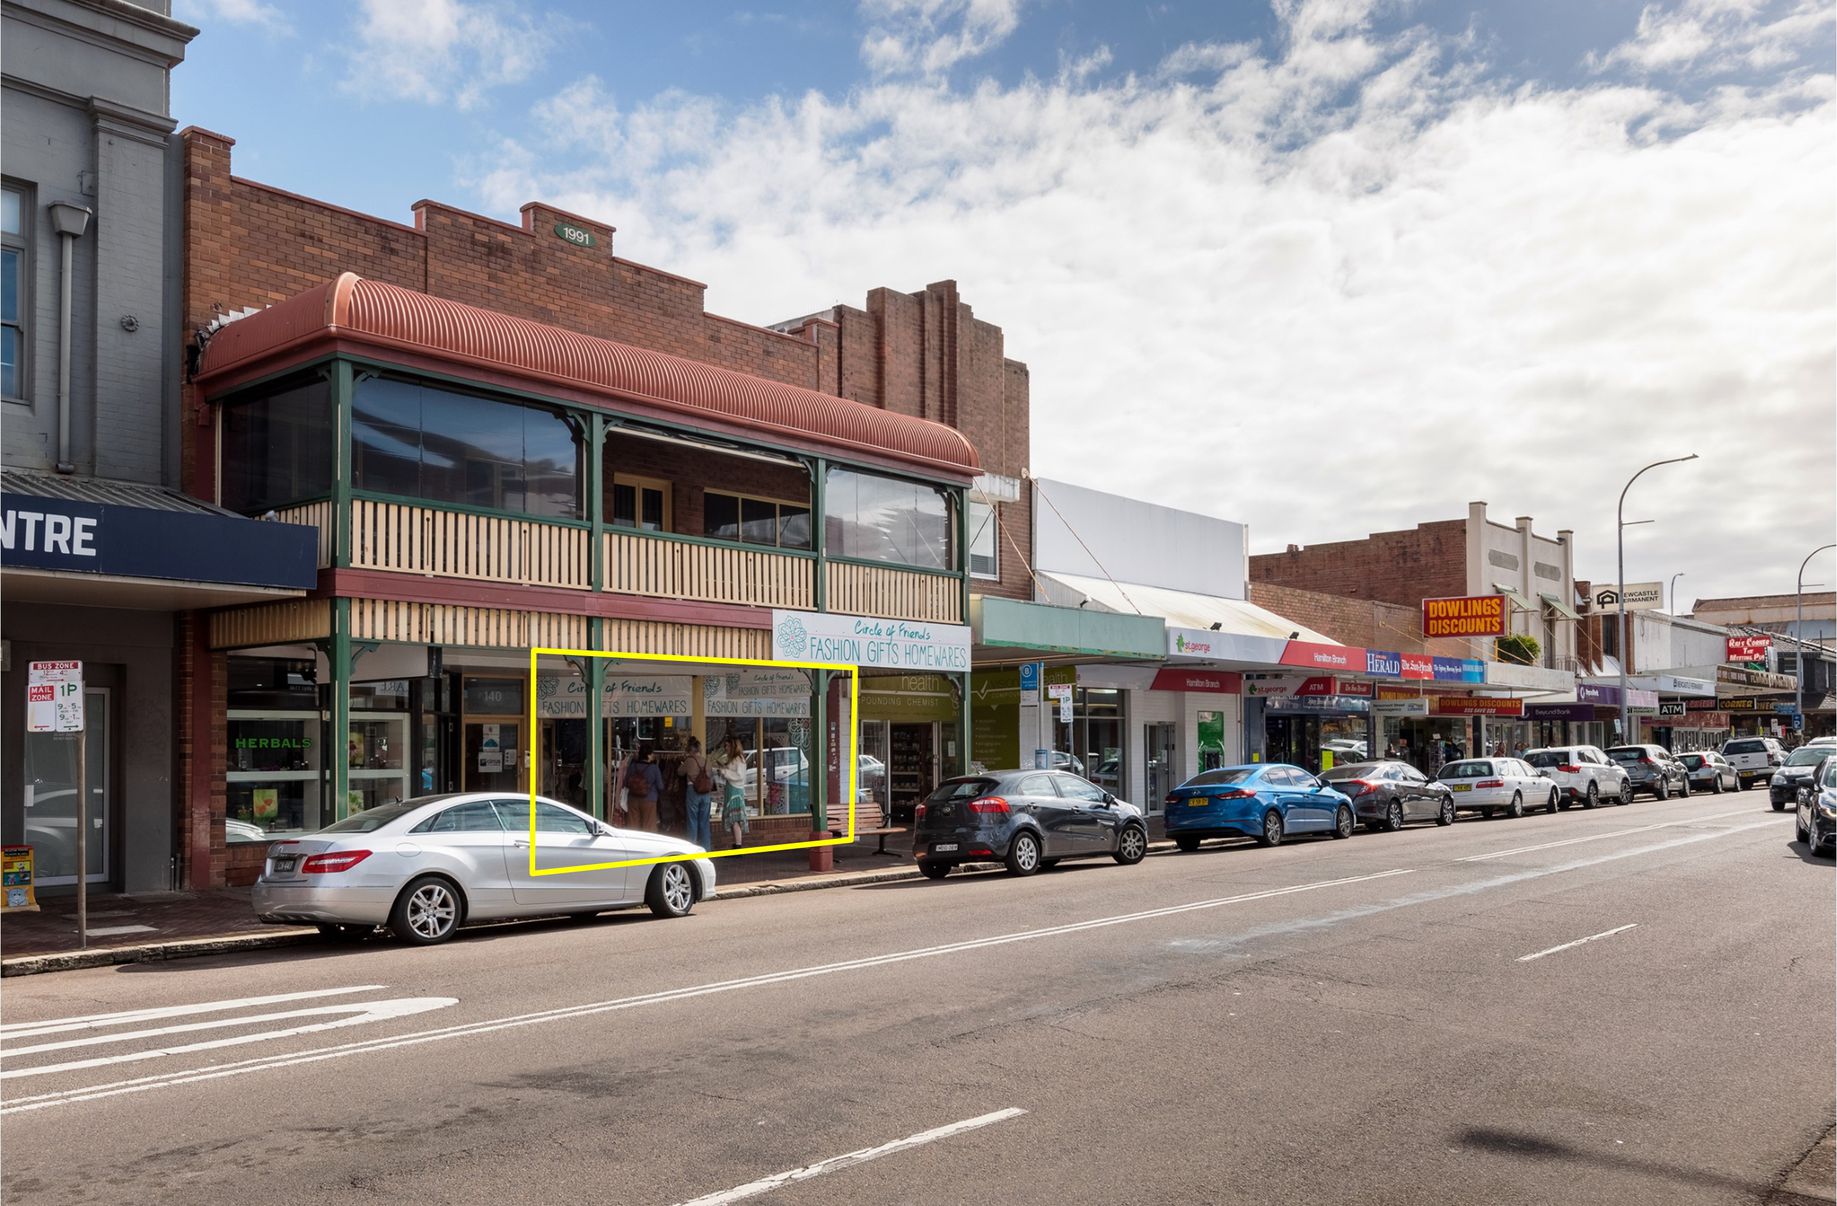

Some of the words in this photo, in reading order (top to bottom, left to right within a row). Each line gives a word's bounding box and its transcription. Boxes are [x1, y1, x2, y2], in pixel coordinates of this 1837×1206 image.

[563, 227, 590, 245] 1991
[0, 510, 97, 556] NTRE
[1623, 590, 1659, 598] EWCASTLE
[1429, 598, 1501, 618] DOWLINGS
[854, 619, 883, 637] Circle
[885, 625, 896, 642] of
[898, 624, 931, 640] Friends
[1429, 617, 1501, 635] DISCOUNTS
[810, 637, 860, 662] FASHION
[867, 641, 899, 666] GIFTS
[904, 644, 967, 669] HOMEWARES
[1367, 652, 1400, 674] HERALD
[901, 672, 940, 691] health
[1042, 672, 1069, 685] ealth
[61, 683, 77, 697] 1P
[567, 682, 587, 694] Cir
[605, 682, 617, 699] of
[621, 680, 662, 693] Friends
[738, 685, 759, 697] FASHION
[762, 684, 777, 695] GIFTS
[543, 701, 584, 714] FASHION
[627, 700, 687, 714] HOMEWARES
[707, 700, 738, 714] FASHION
[742, 700, 762, 714] GIFTS
[766, 701, 807, 714] HOMEWARES
[907, 697, 939, 707] CHEMIST
[1440, 699, 1478, 707] DOWLINGS
[1479, 699, 1521, 708] DISCOUNTS
[1720, 700, 1753, 708] CORNER
[1661, 705, 1683, 714] ATM
[235, 738, 312, 750] HERBALS
